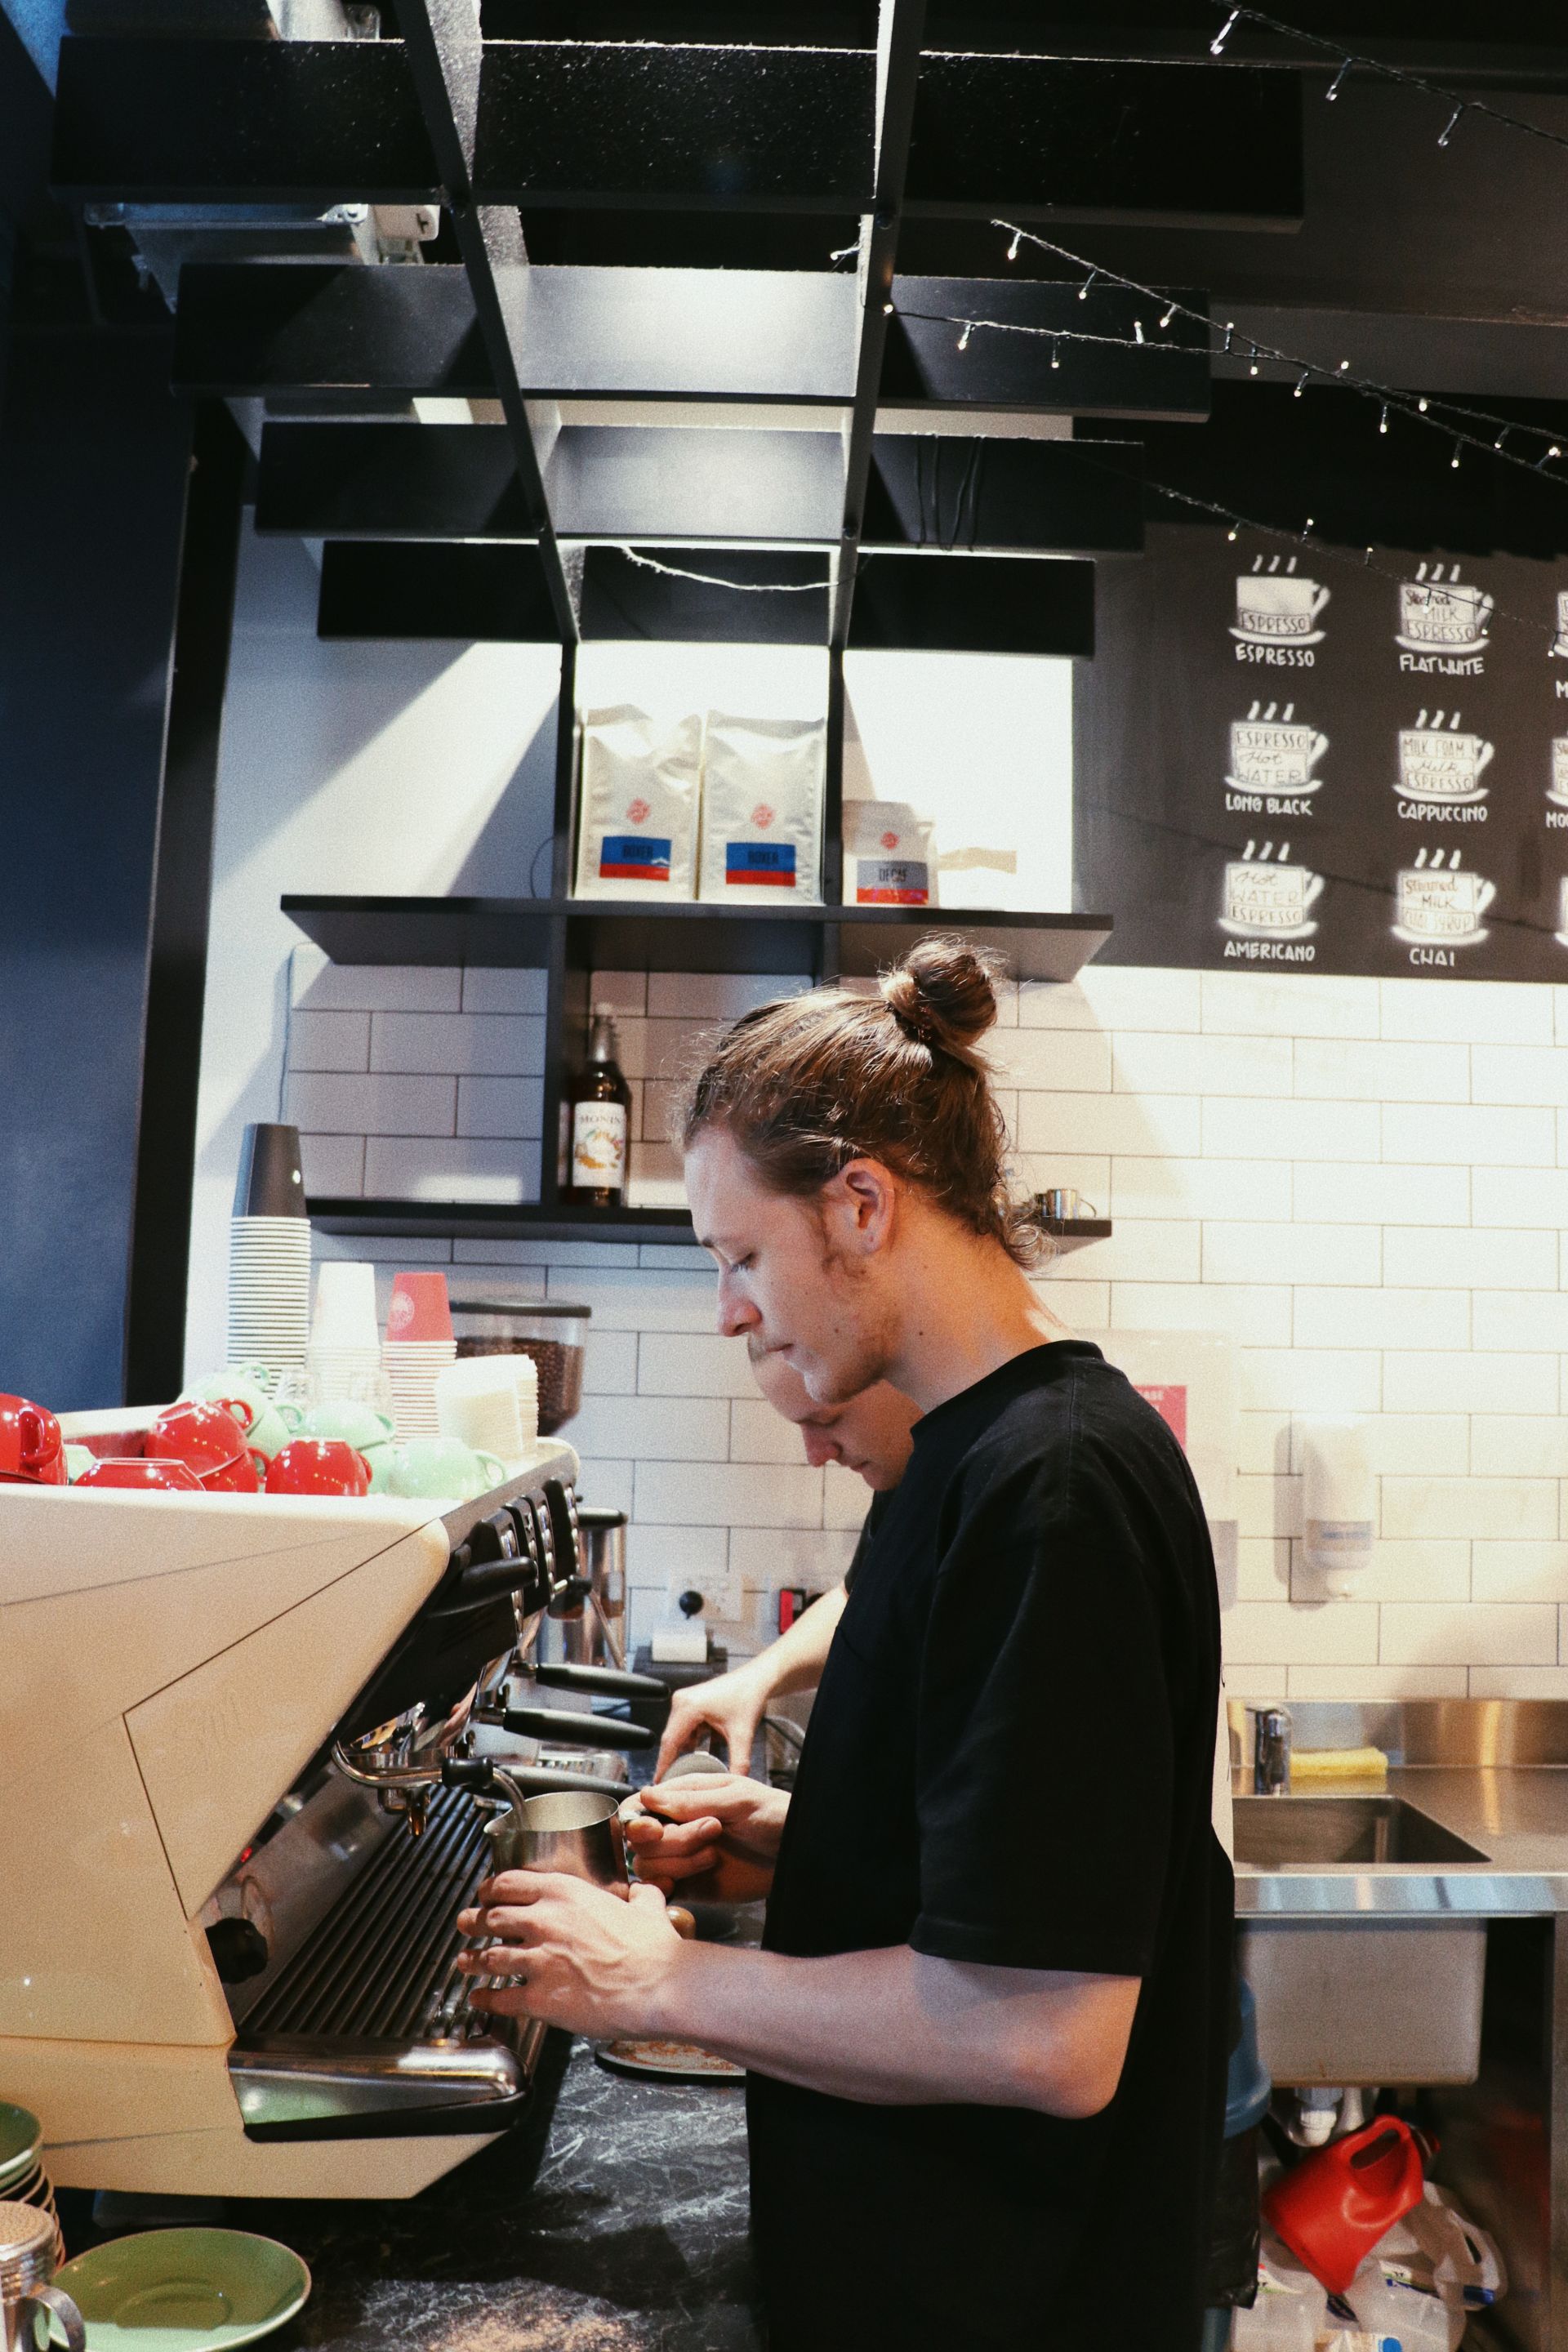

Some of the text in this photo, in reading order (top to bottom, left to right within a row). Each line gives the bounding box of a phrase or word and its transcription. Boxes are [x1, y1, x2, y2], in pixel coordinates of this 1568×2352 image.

[1406, 622, 1475, 642] ESPRESSO
[1236, 643, 1315, 667] ESPRESSO
[1236, 731, 1307, 749] ESPRESSO
[1405, 773, 1470, 790] ESPRESSO
[1226, 793, 1313, 816] LONG BLACK
[1397, 801, 1488, 822] CAPPUCCINO
[1224, 941, 1316, 961] AMERICANO
[1410, 947, 1454, 967] CHAI
